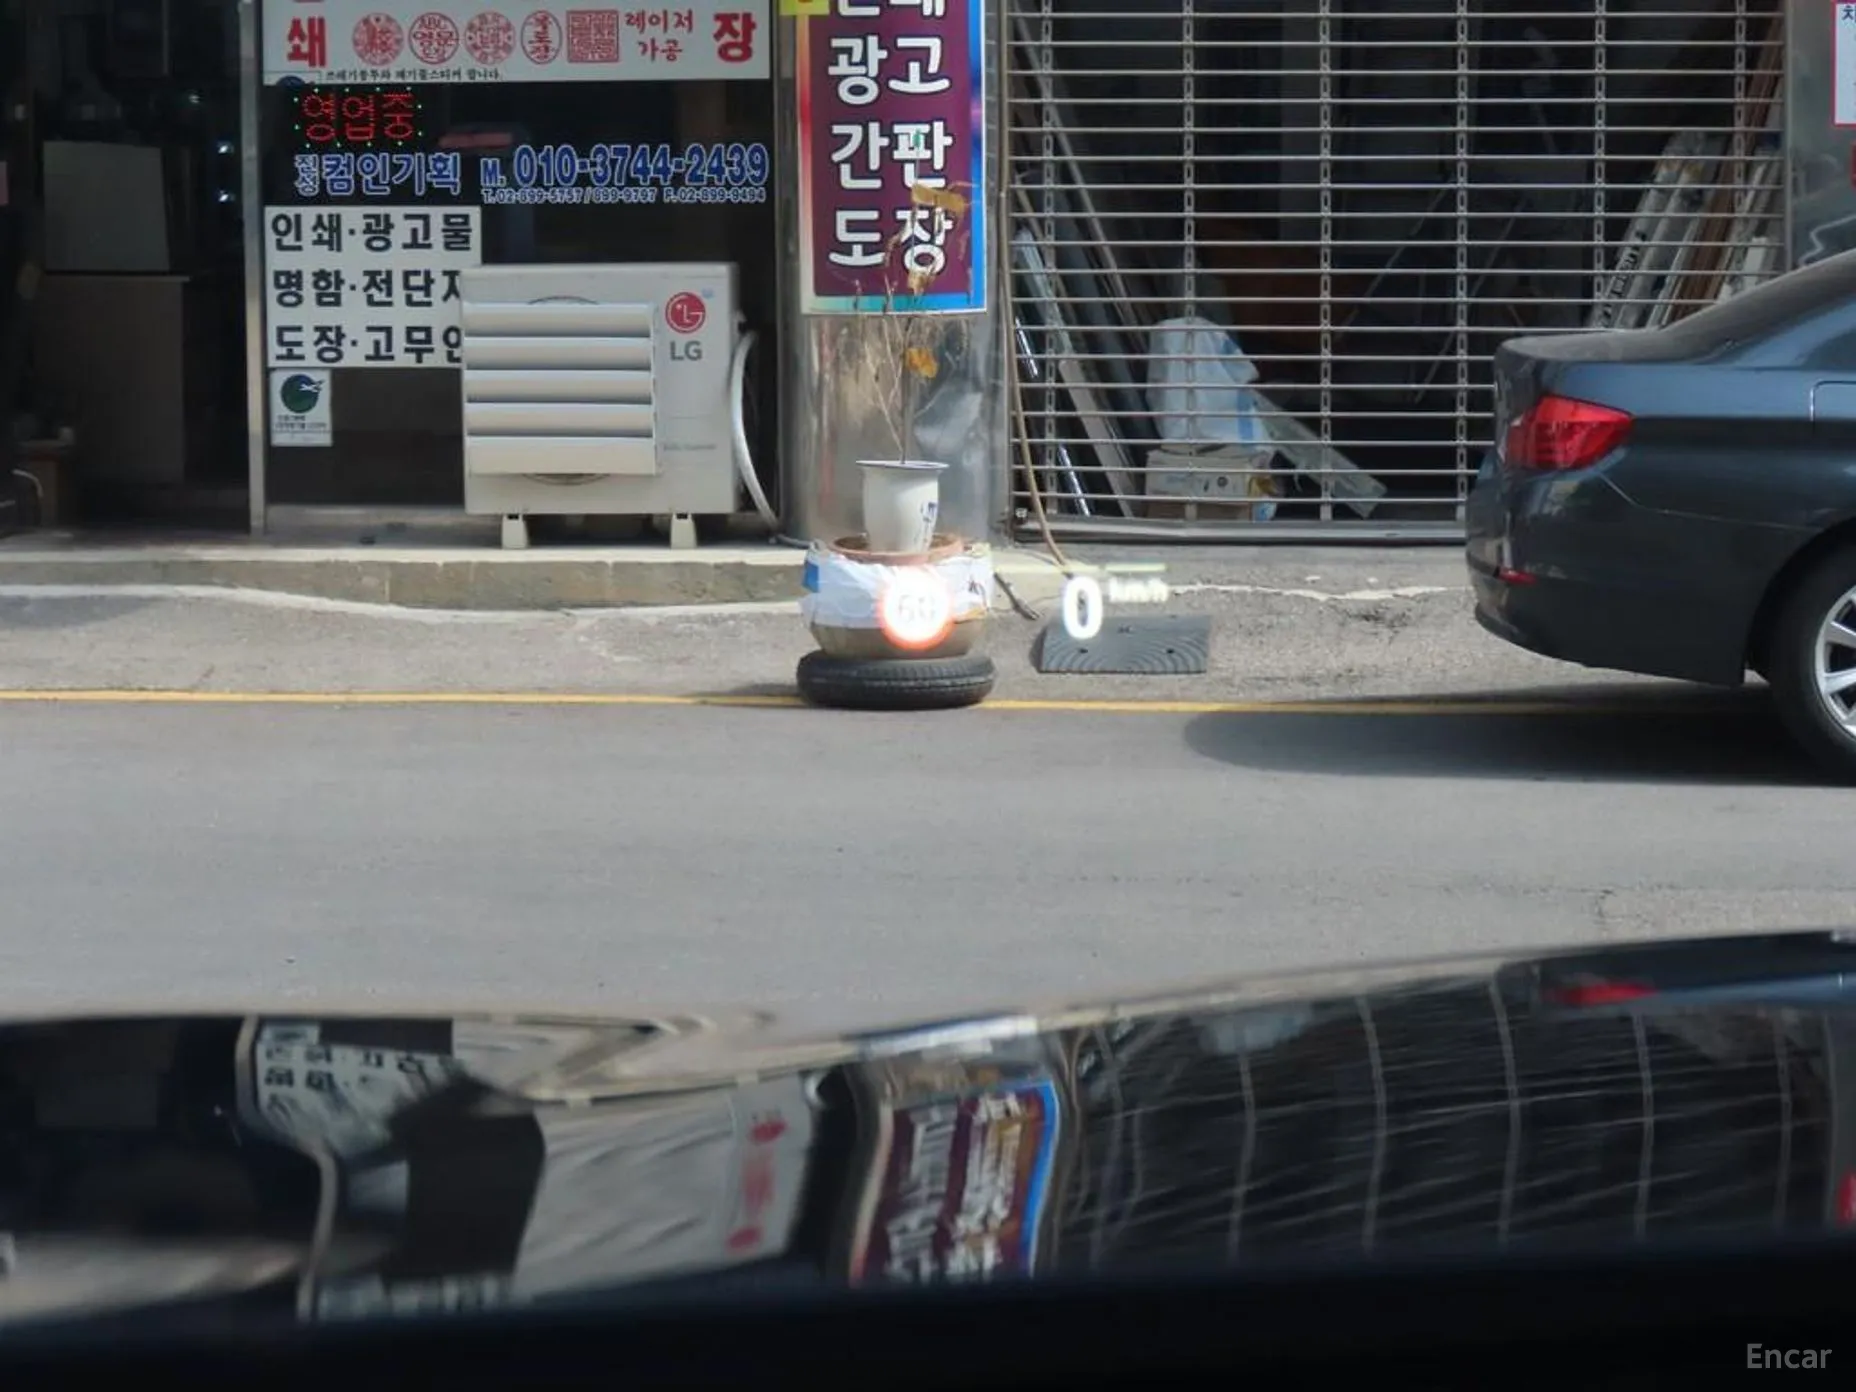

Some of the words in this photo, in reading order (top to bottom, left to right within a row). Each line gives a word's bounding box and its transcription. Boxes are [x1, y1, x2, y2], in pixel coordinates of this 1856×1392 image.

[625, 9, 694, 34] 레이저
[713, 12, 757, 64] 장
[637, 38, 684, 61] 가공
[827, 34, 950, 105] 광고
[303, 93, 413, 142] 영업중
[480, 158, 507, 188] M.
[514, 143, 769, 187] 010-3744-2439
[830, 120, 954, 190] 간판
[271, 213, 473, 252] 인쇄·광고물
[827, 208, 955, 274] 도장
[669, 340, 703, 362] LG
[1061, 574, 1103, 640] 0
